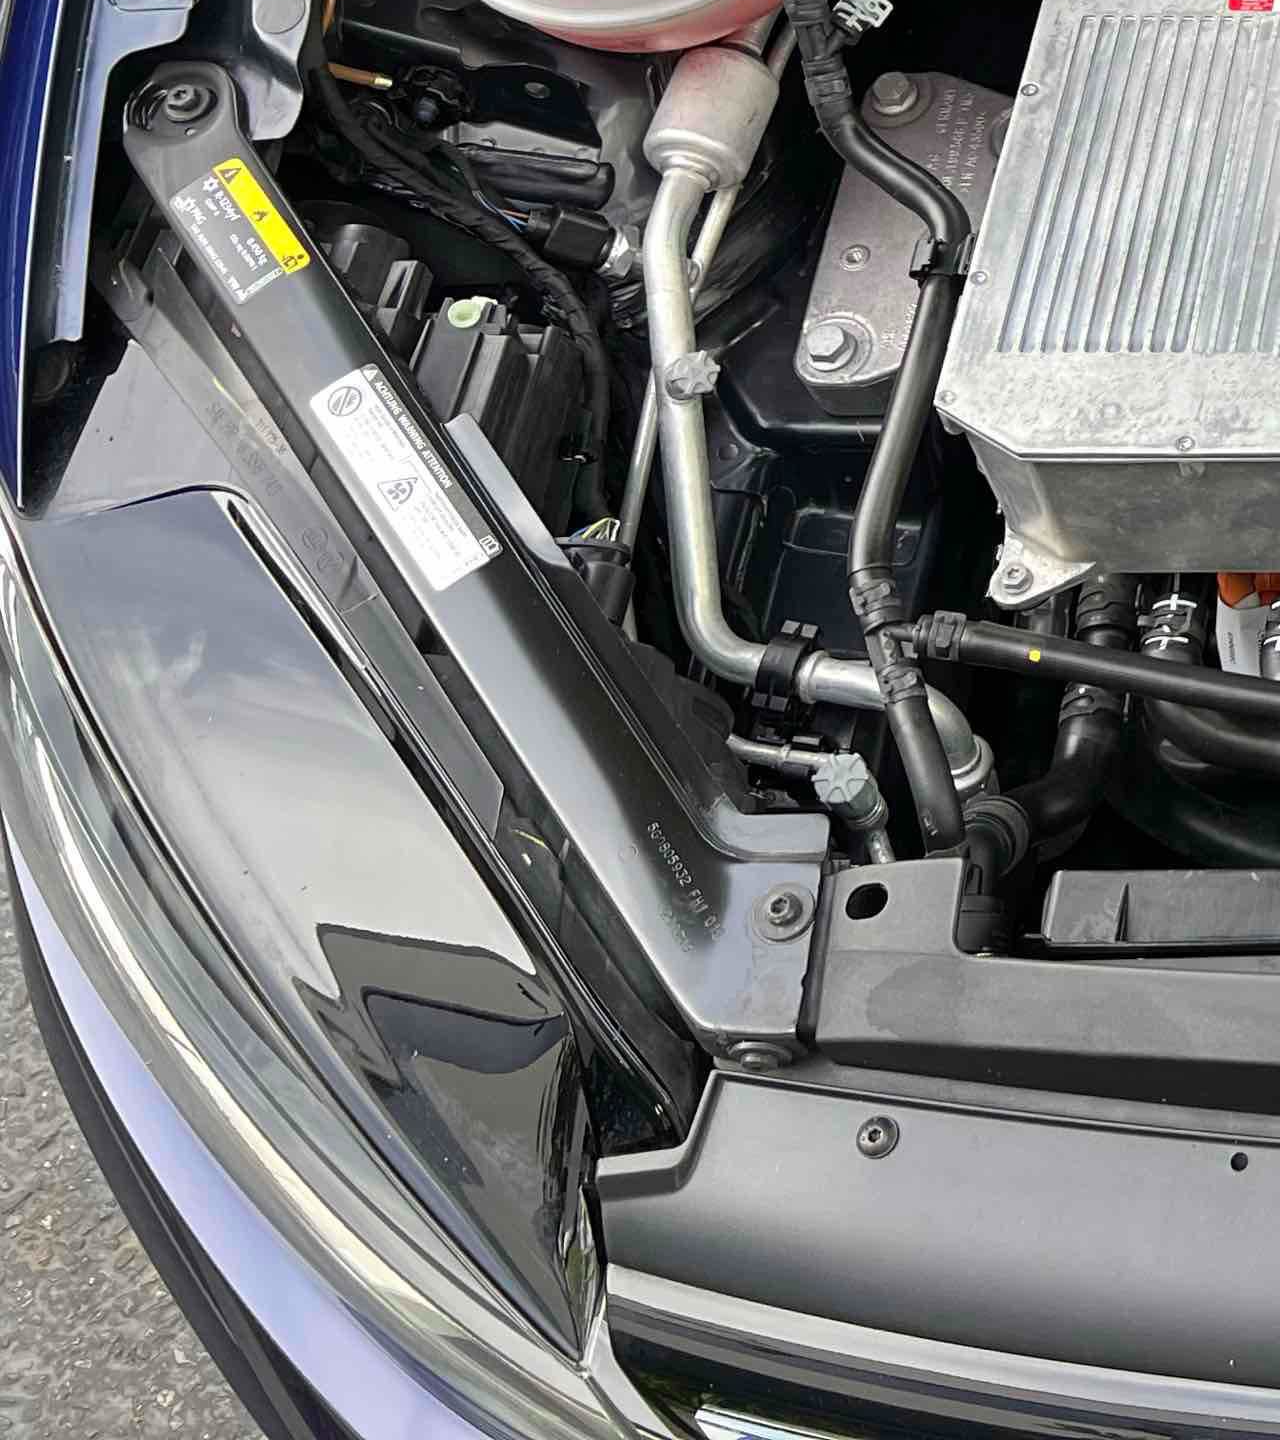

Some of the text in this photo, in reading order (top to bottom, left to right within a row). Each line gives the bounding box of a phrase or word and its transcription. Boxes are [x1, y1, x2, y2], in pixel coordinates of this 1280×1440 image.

[372, 379, 453, 489] ACHTUNG WARNING ATTENTION
